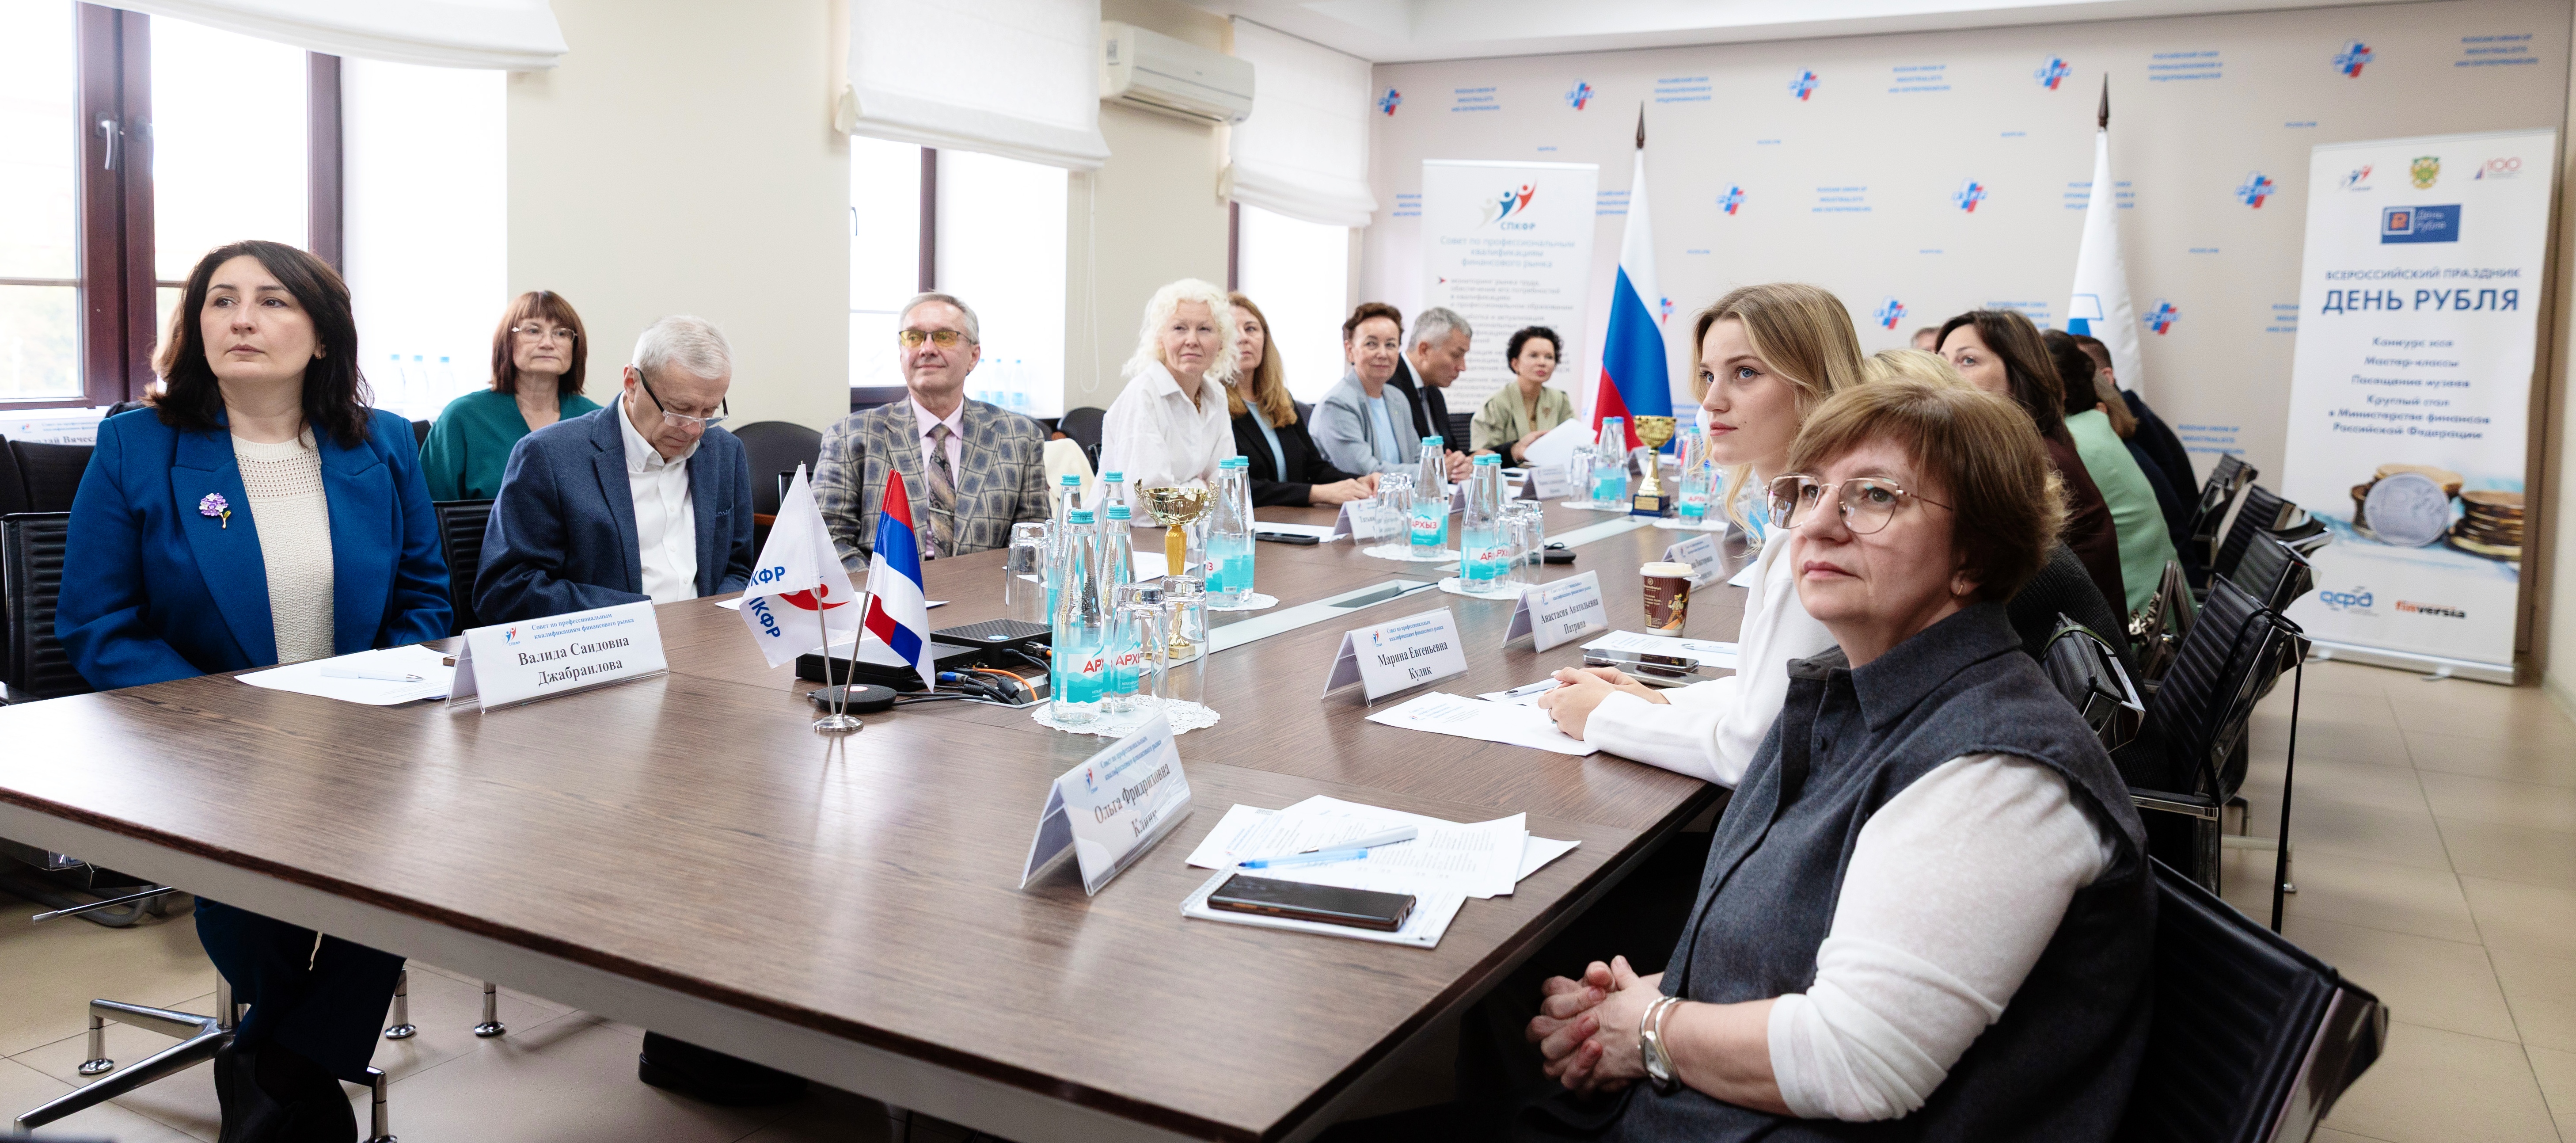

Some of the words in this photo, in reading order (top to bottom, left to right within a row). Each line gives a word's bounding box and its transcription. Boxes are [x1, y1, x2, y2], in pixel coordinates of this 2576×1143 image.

[1440, 236, 1467, 245] Совет
[2325, 267, 2440, 281] ВСЕРОССИЙСКИЙ
[2443, 267, 2522, 279] ПРАЗДНИК
[2322, 289, 2403, 315] ДЕНЬ
[2414, 288, 2519, 311] РУБЛЯ
[748, 566, 785, 588] КФР
[559, 613, 612, 628] профессиональным
[1541, 608, 1568, 624] Анастасия
[1569, 598, 1599, 615] Анатольевна
[534, 627, 581, 639] квалификациям
[581, 621, 616, 633] финансового
[617, 618, 635, 626] рынка
[1564, 620, 1586, 634] Патрина
[517, 648, 567, 666] Валида
[570, 637, 630, 655] Саидовна
[1377, 651, 1409, 667] Марина
[1408, 641, 1448, 659] Евгеньевна
[538, 659, 623, 688] Джабраилова
[1408, 666, 1432, 681] Кулик
[1094, 797, 1123, 824] Ольга
[1122, 763, 1170, 806] Фридриховна
